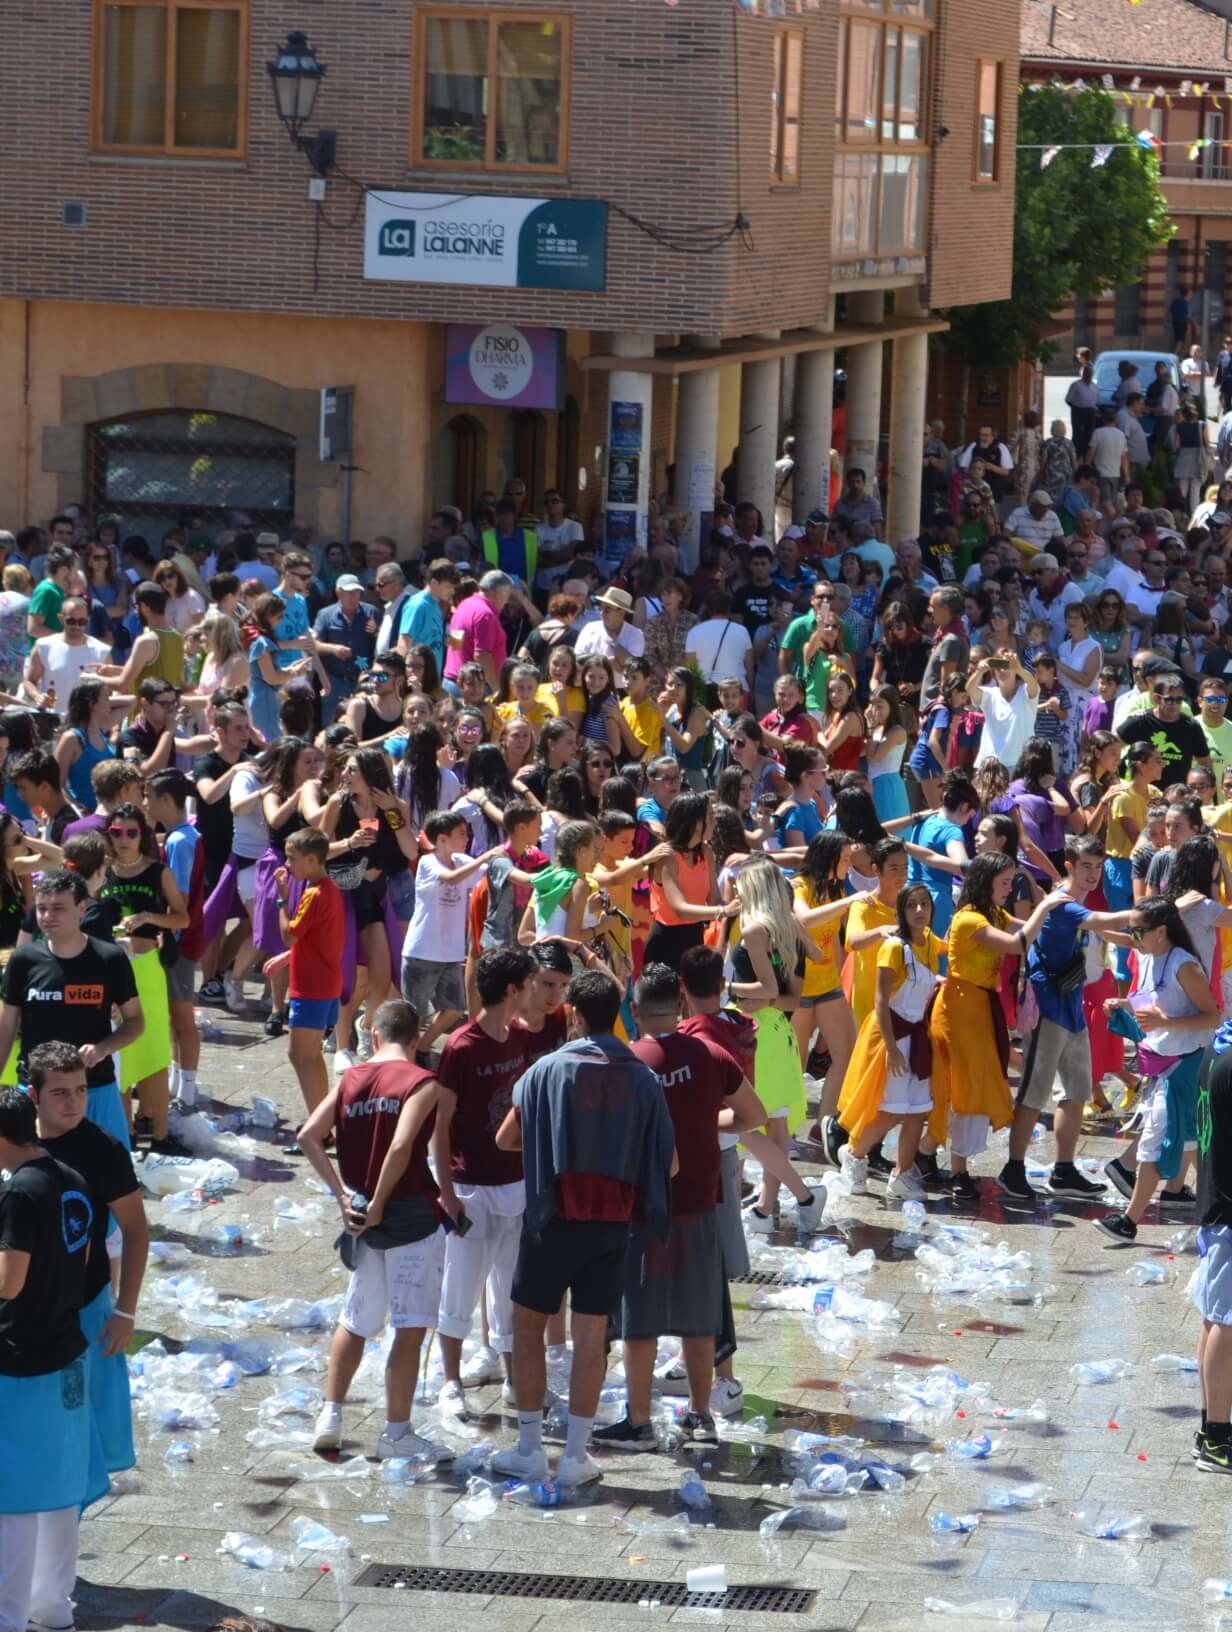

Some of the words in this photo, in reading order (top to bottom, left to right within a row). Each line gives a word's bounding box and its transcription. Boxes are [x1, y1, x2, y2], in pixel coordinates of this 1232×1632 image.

[424, 219, 505, 237] asesoría
[485, 336, 519, 352] FISIO
[27, 988, 62, 1001] Pura
[68, 989, 101, 1000] vida
[344, 1096, 400, 1118] VICTOR
